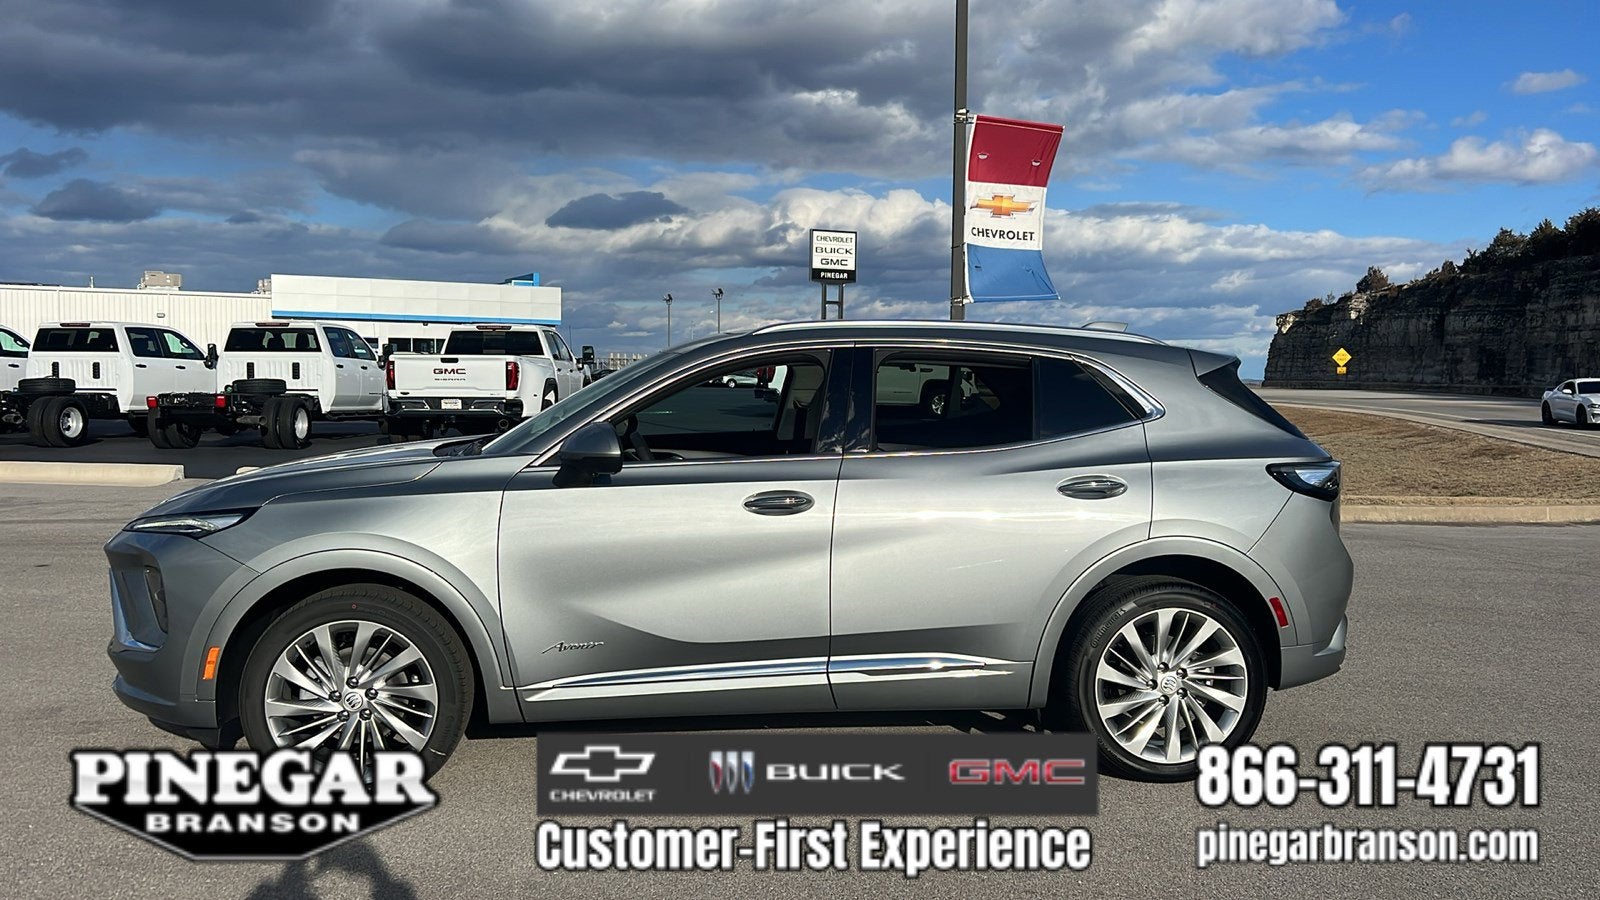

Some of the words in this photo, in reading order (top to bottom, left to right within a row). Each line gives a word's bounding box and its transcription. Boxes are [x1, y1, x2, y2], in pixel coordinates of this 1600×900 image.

[971, 227, 1035, 241] CHEVROLET
[816, 235, 853, 243] CHEVROLET
[820, 258, 848, 266] GMC
[820, 271, 848, 279] PINEGAR
